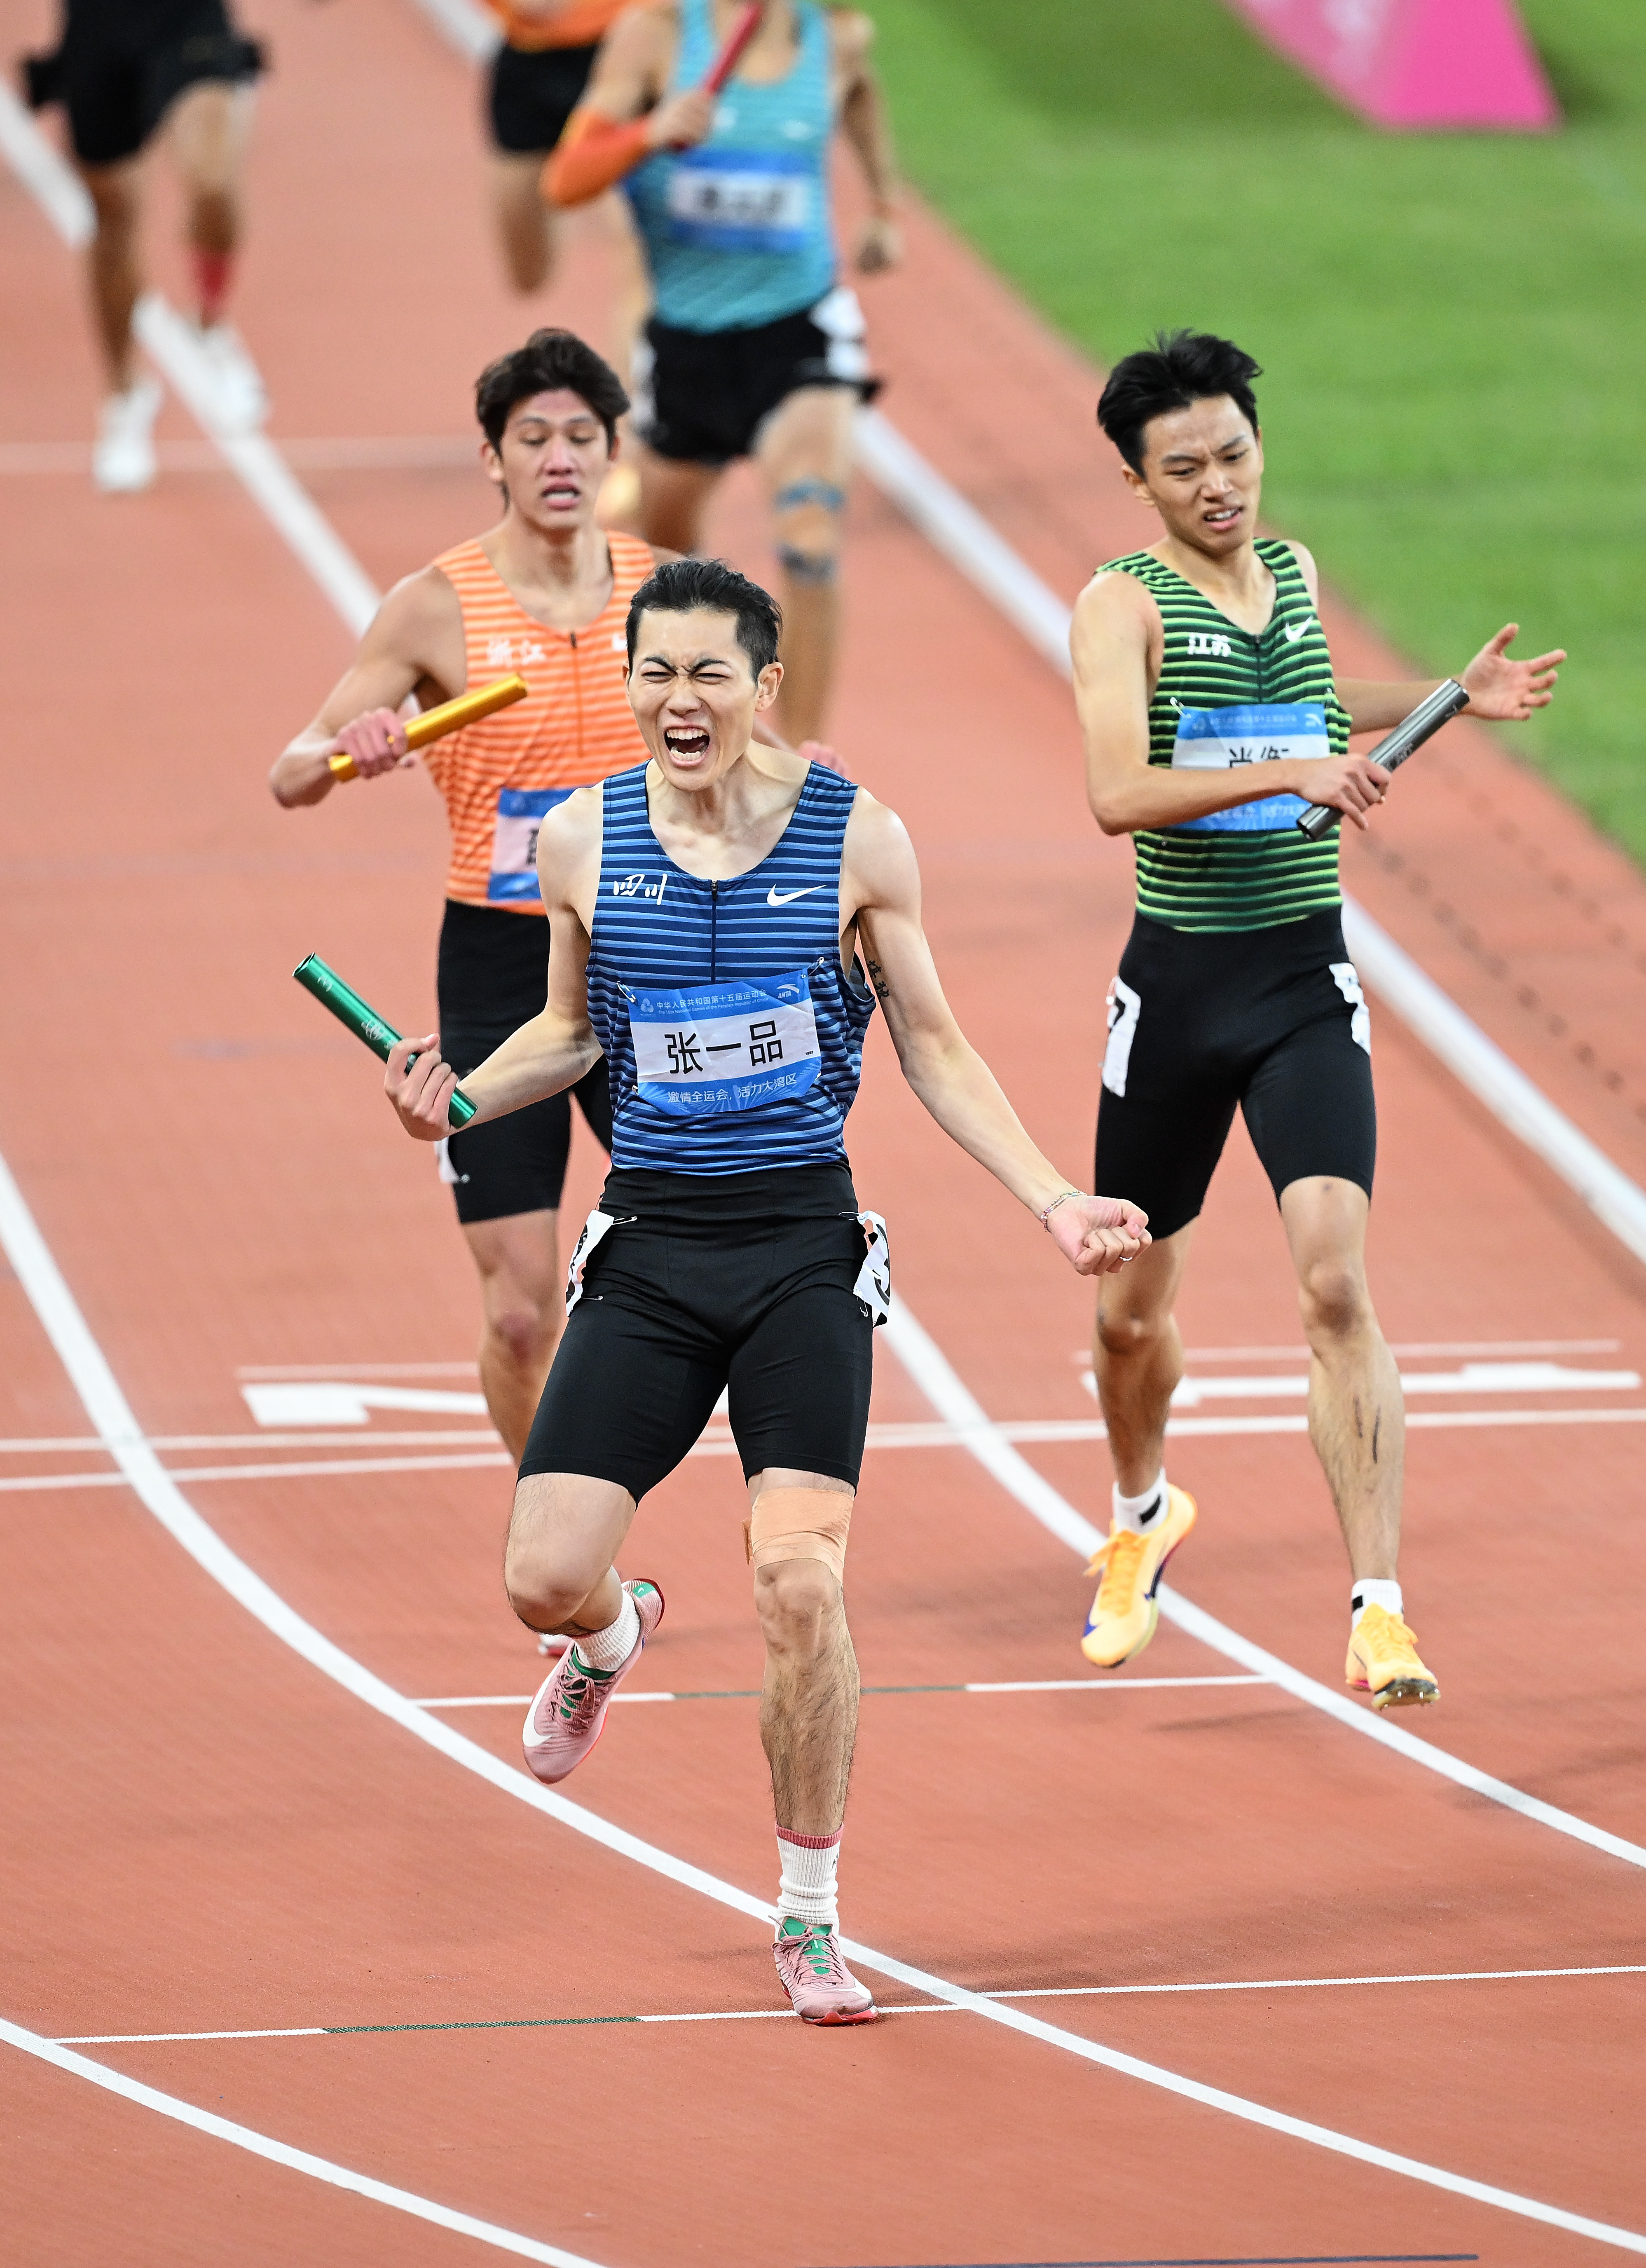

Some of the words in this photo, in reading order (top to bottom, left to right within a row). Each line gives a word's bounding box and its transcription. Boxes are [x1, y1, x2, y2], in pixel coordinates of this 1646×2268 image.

[613, 873, 668, 905] 四川
[657, 989, 767, 1009] 中华人民共和国第十五届运动会
[778, 990, 791, 998] ANTA
[664, 1020, 784, 1074] 张一品
